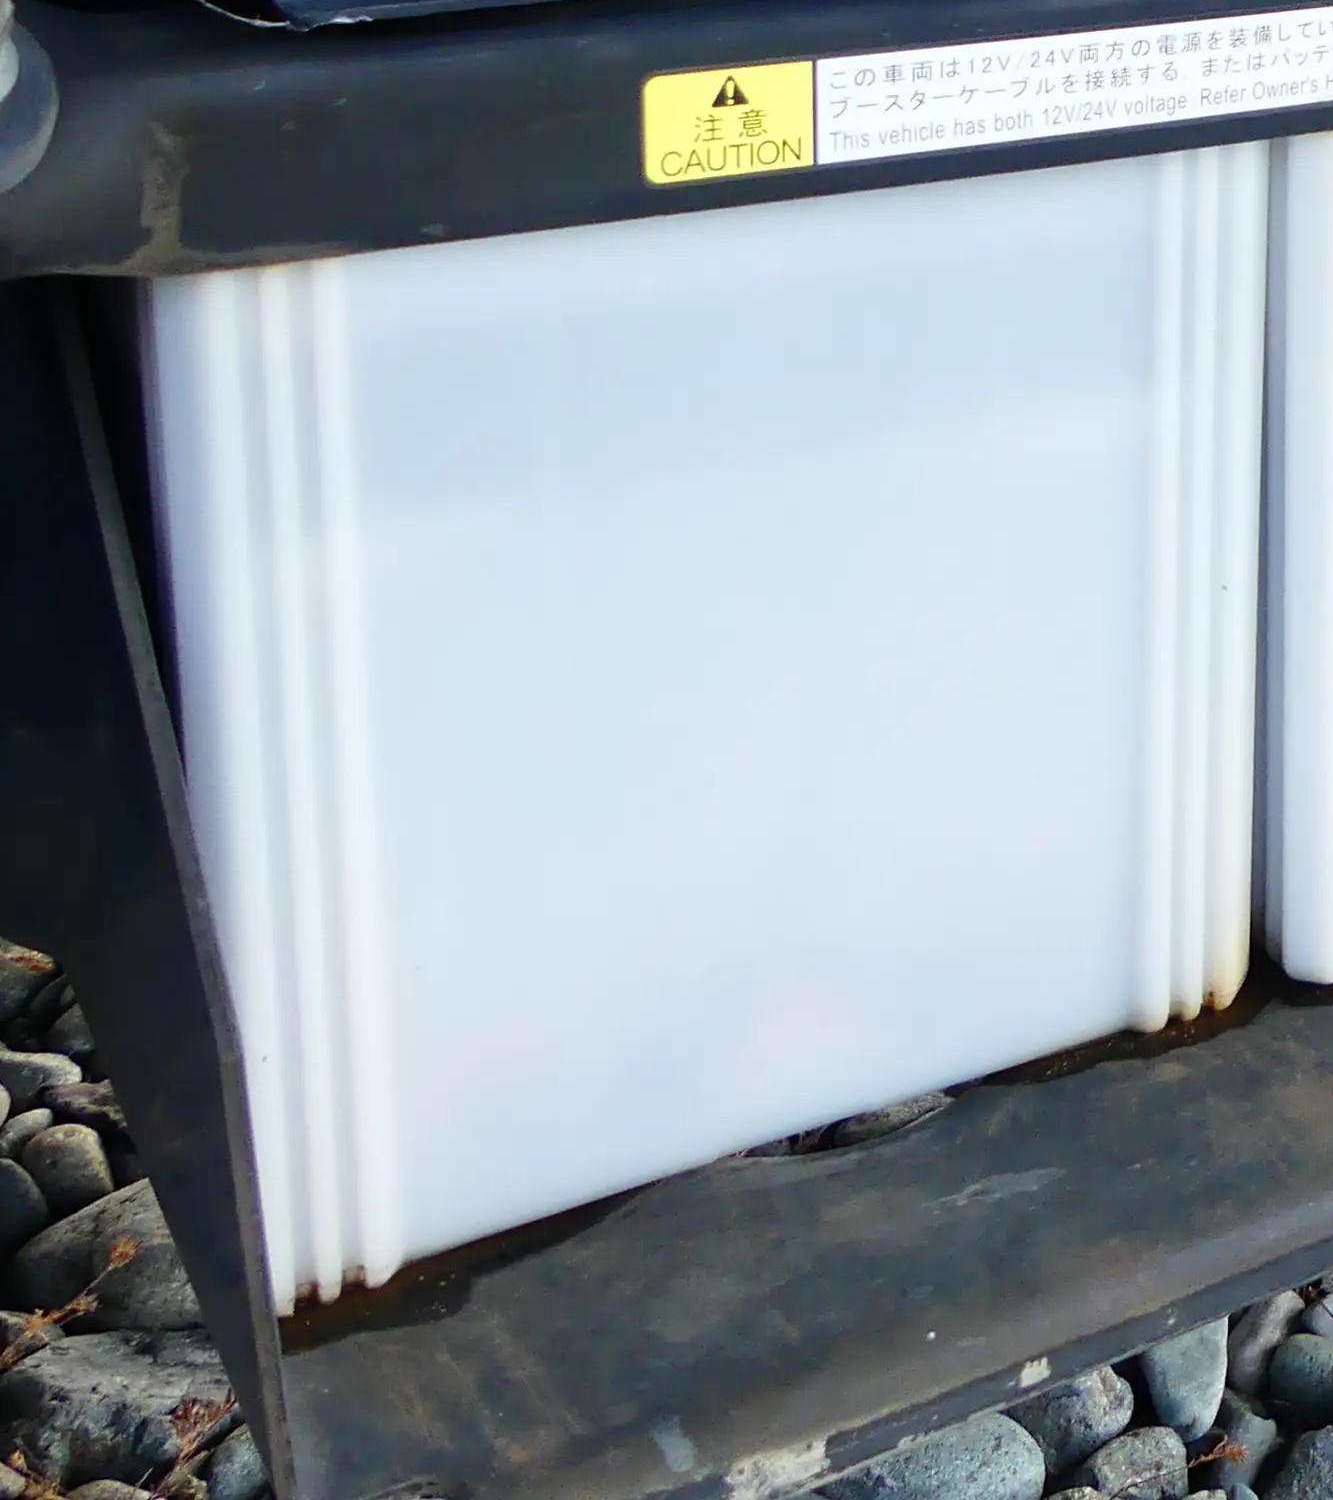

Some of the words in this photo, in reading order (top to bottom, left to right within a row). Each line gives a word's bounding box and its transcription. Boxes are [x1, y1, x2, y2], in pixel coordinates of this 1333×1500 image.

[693, 108, 769, 143] 注意
[829, 130, 871, 153] This
[878, 122, 946, 146] vehicle
[953, 117, 986, 137] has
[994, 110, 1034, 133] both
[1042, 98, 1118, 129] 12V/24V
[1200, 84, 1247, 107] Refer
[1252, 77, 1319, 101] Owner's
[660, 137, 803, 177] CAUTION
